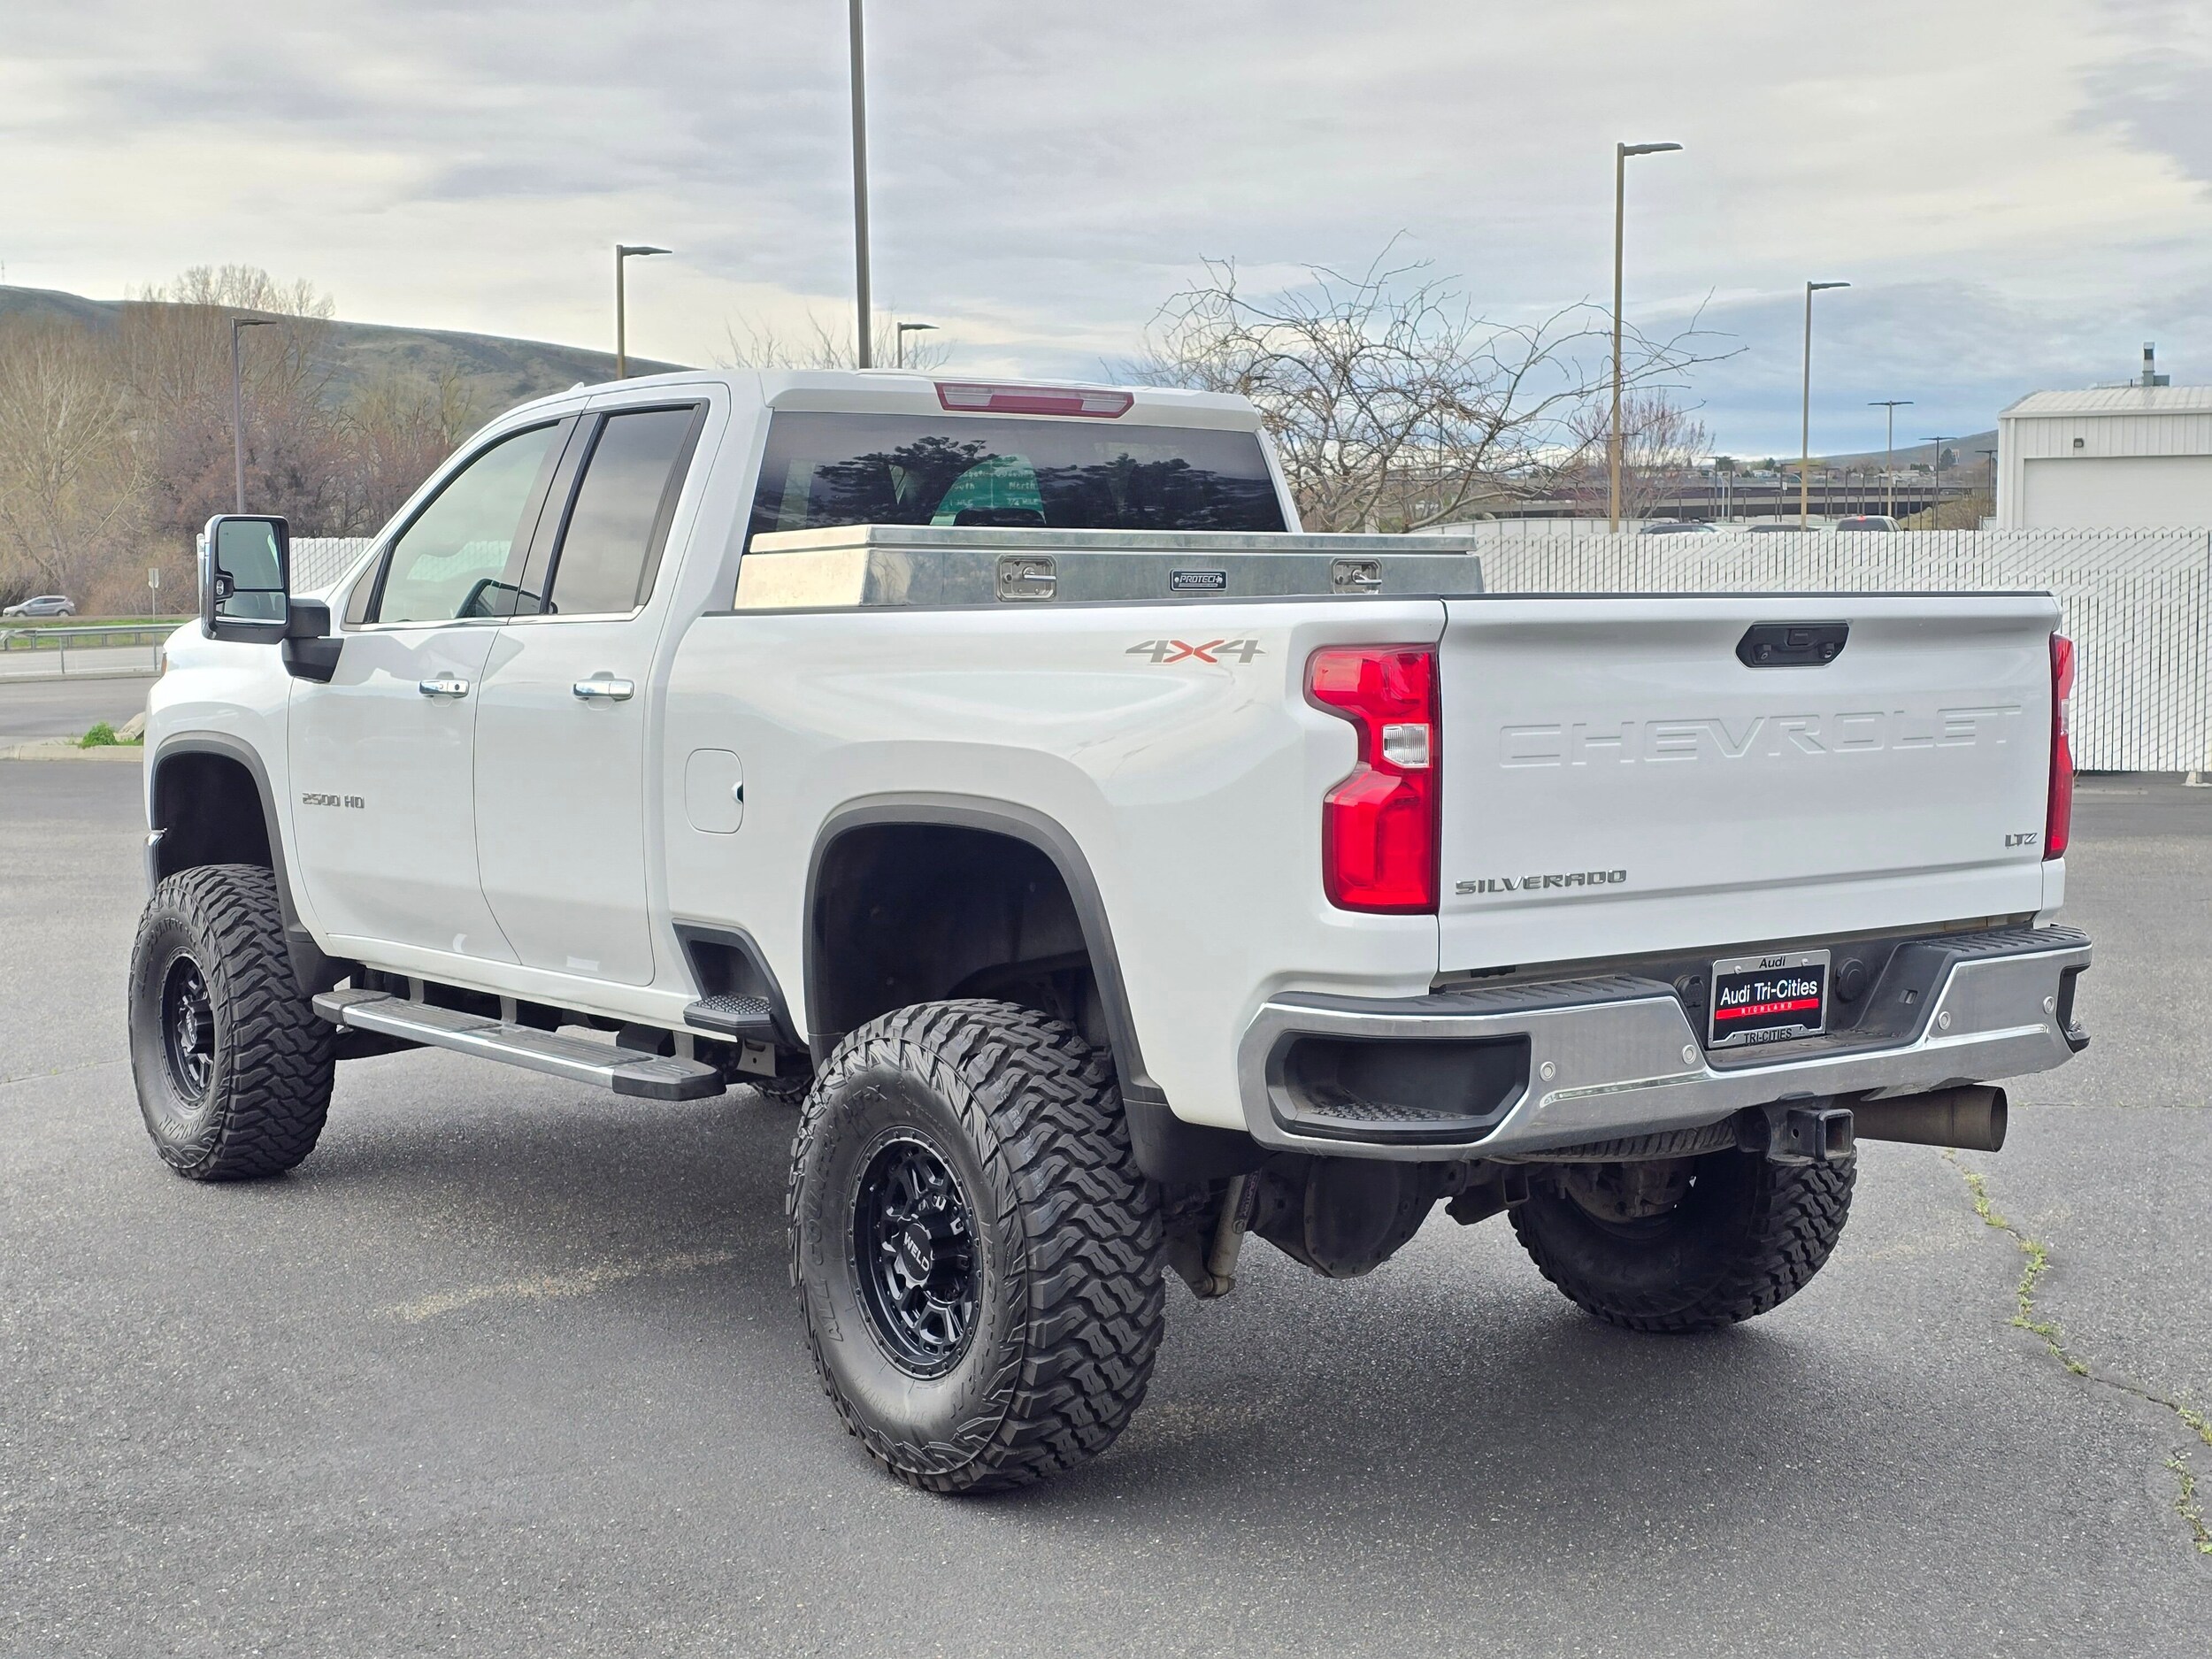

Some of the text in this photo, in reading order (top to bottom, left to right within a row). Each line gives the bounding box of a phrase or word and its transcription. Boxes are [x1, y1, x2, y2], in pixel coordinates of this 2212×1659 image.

[1500, 705, 2022, 767] CHEVROLET
[302, 793, 365, 809] 2500 HD
[2004, 833, 2038, 847] LTZ
[1455, 869, 1627, 895] SILVERADO
[1758, 956, 1786, 969] Audi
[1720, 978, 1817, 1006] Audi Tri-Cities
[1741, 1002, 1793, 1015] RICHLAND
[1744, 1028, 1793, 1044] TRI-CITIES
[904, 1232, 929, 1272] WELD
